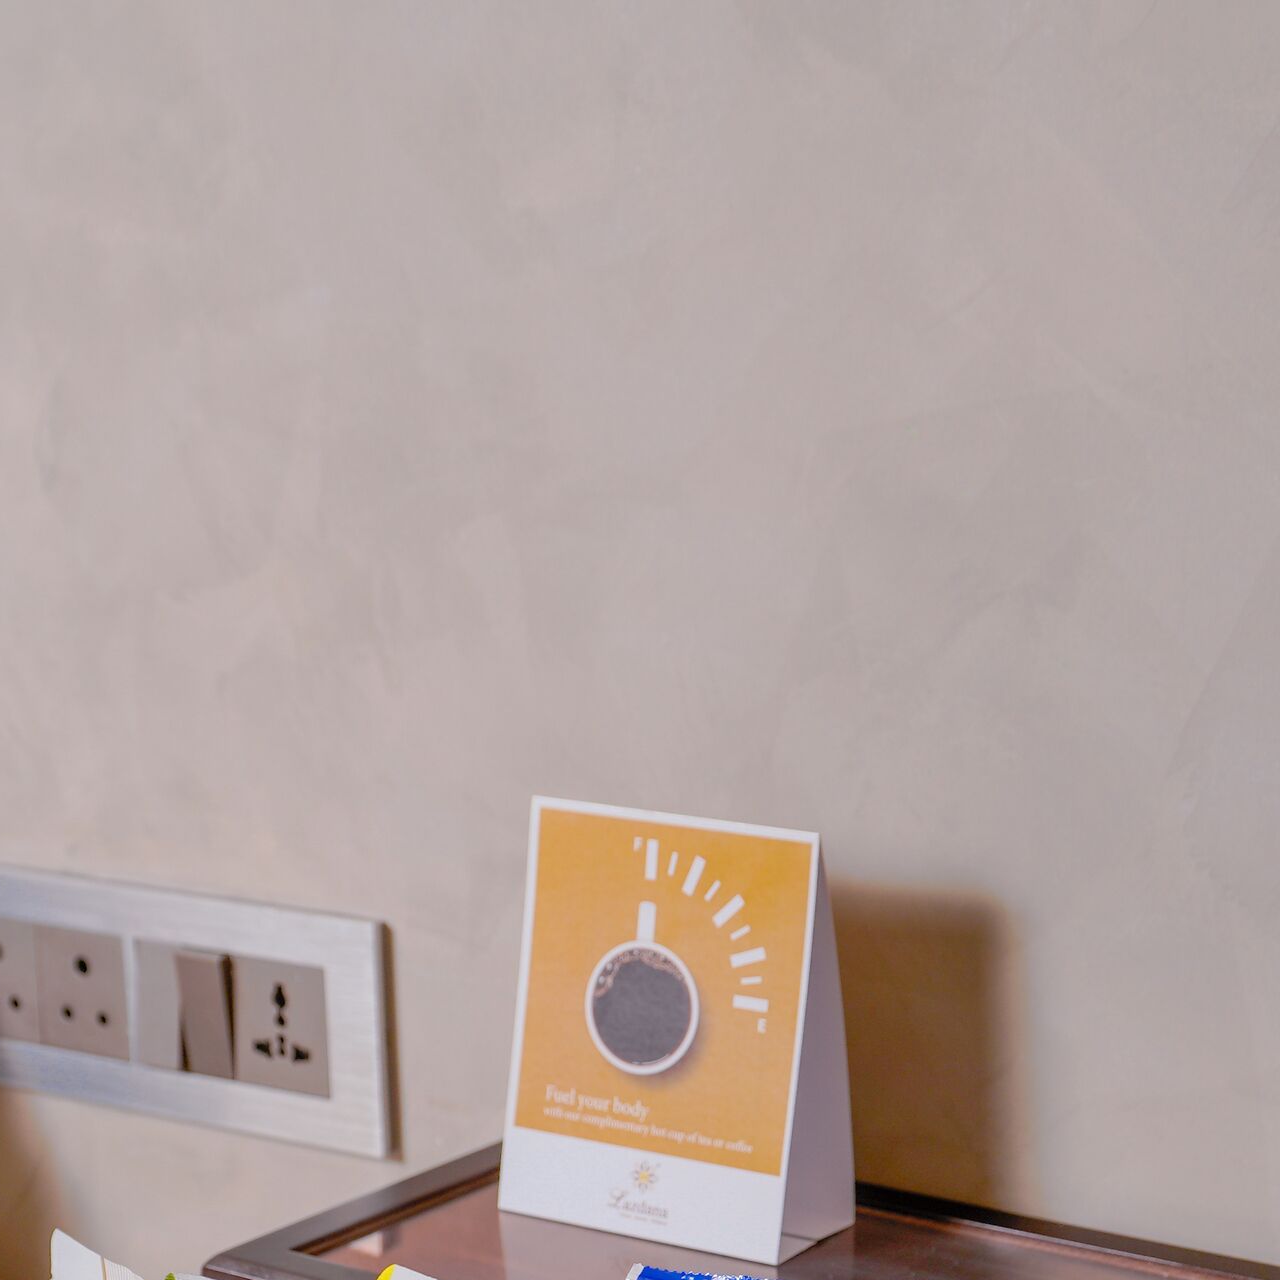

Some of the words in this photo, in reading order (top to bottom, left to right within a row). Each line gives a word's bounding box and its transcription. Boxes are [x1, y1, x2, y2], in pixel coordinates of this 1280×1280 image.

[546, 1084, 576, 1105] Fuel
[577, 1093, 610, 1111] your
[613, 1096, 649, 1121] body
